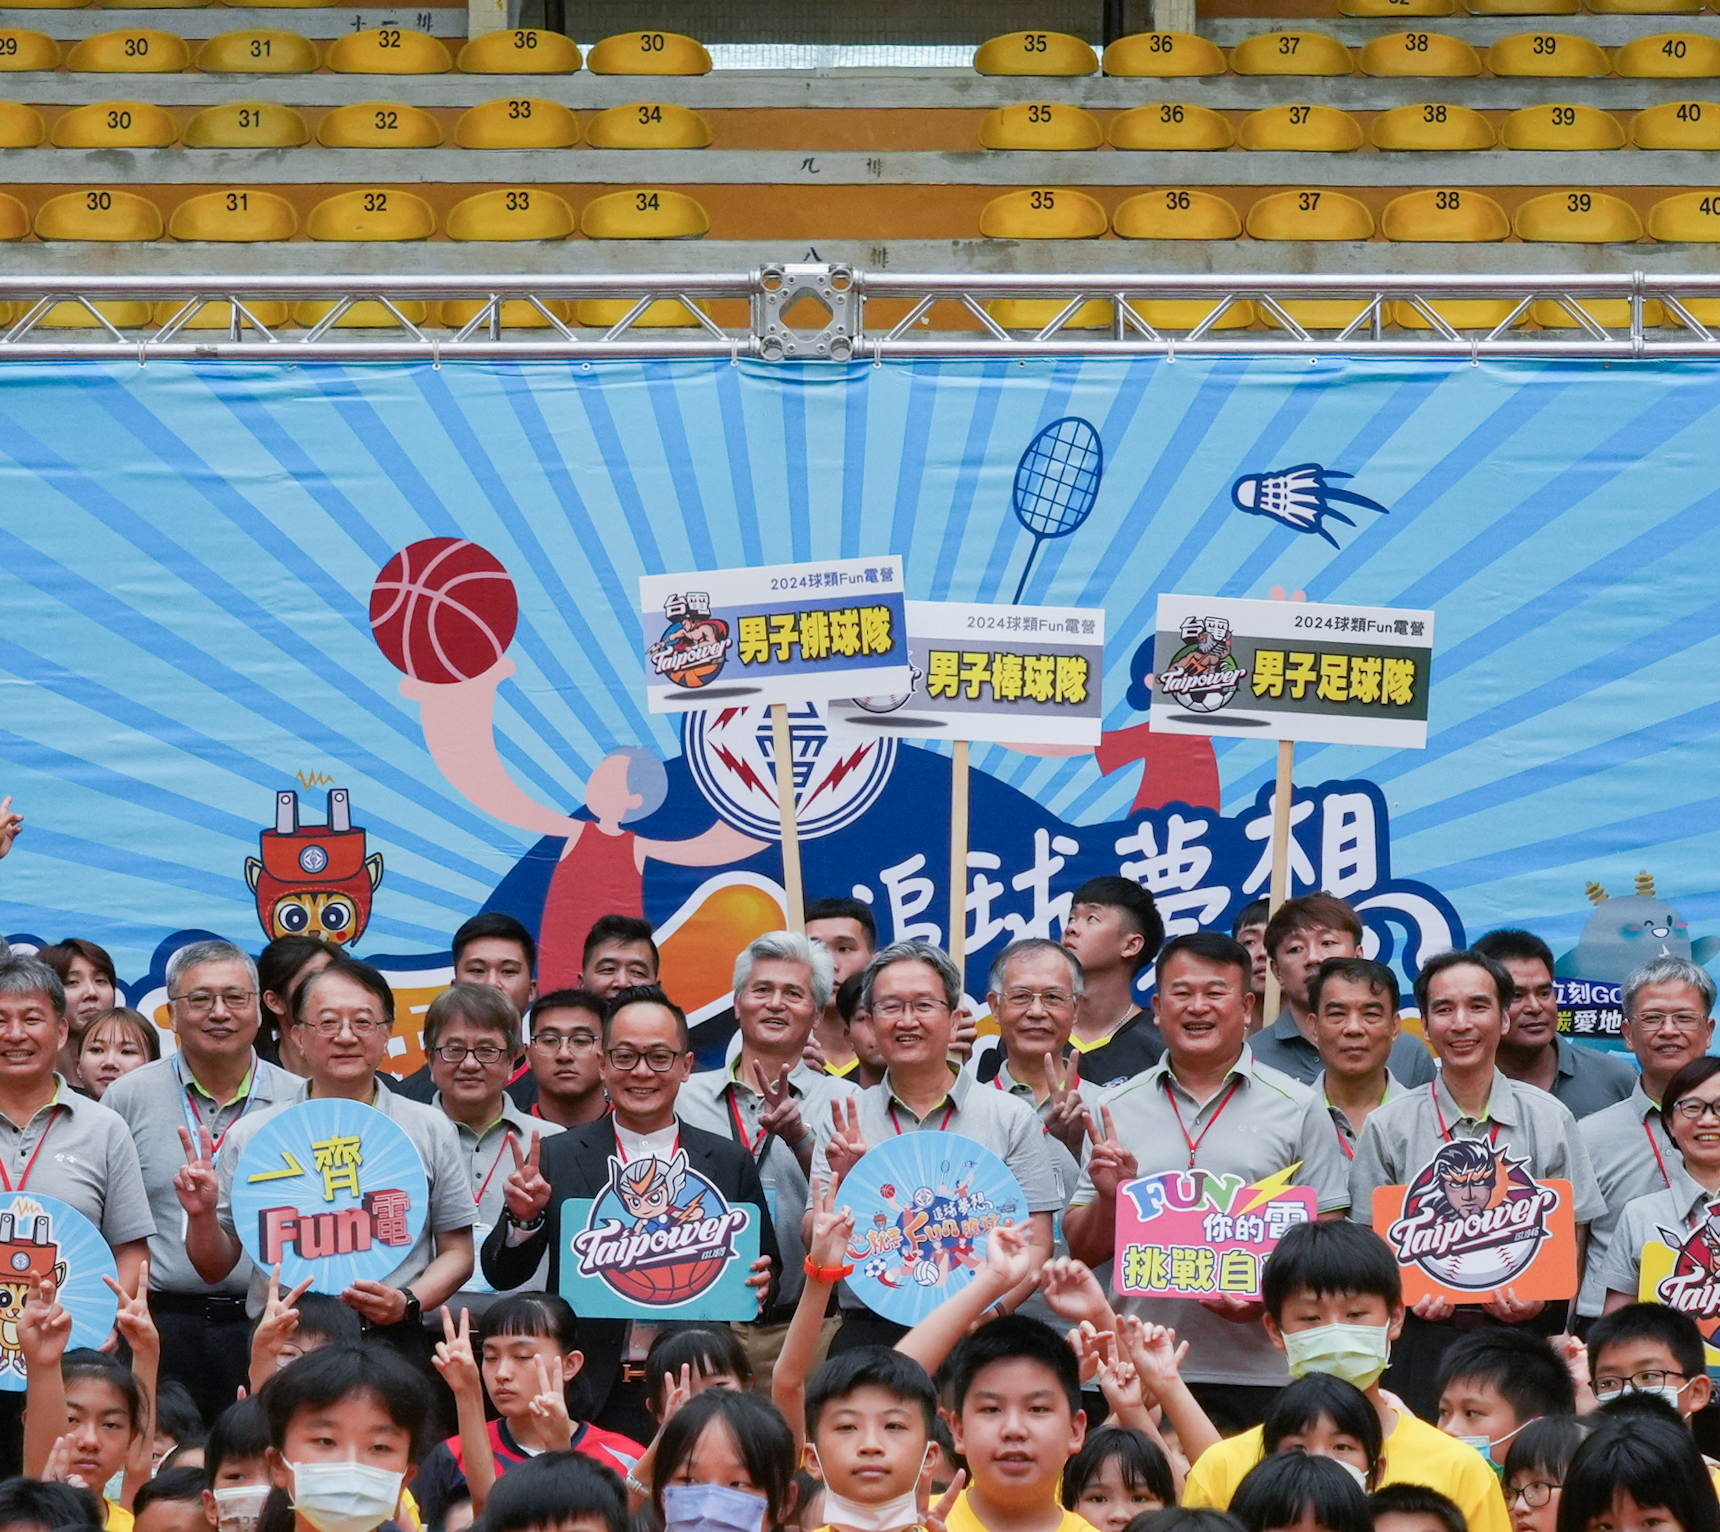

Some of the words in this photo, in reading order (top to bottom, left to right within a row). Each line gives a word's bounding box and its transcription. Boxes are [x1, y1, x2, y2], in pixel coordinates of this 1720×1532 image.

[249, 38, 271, 59] 31
[377, 28, 401, 49] 32
[513, 29, 538, 50] 36
[639, 32, 665, 53] 30
[1023, 33, 1047, 54] 35
[1278, 35, 1301, 56] 37
[1532, 35, 1557, 56] 39
[237, 108, 260, 129] 31
[507, 99, 532, 121] 33
[1027, 104, 1052, 124] 35
[1288, 105, 1311, 126] 37
[1550, 106, 1576, 127] 39
[85, 190, 112, 212] 30
[363, 192, 387, 213] 32
[635, 192, 660, 213] 34
[1165, 190, 1190, 211] 36
[770, 566, 895, 591] 2024球類Fun電營
[736, 605, 893, 666] 男子排球隊
[966, 615, 1097, 637] 2024球類Fun電營
[1294, 615, 1426, 637] 2024球類Fun電營
[651, 638, 734, 676] Taipower
[928, 649, 1089, 705] 男子棒球隊
[1159, 667, 1247, 695] Taipower
[1252, 648, 1416, 706] 男子足球隊
[1122, 1169, 1246, 1222] FUN
[1387, 1187, 1561, 1266] Taipower
[573, 1208, 750, 1278] Taipower
[1122, 1243, 1266, 1296] 挑戰自
